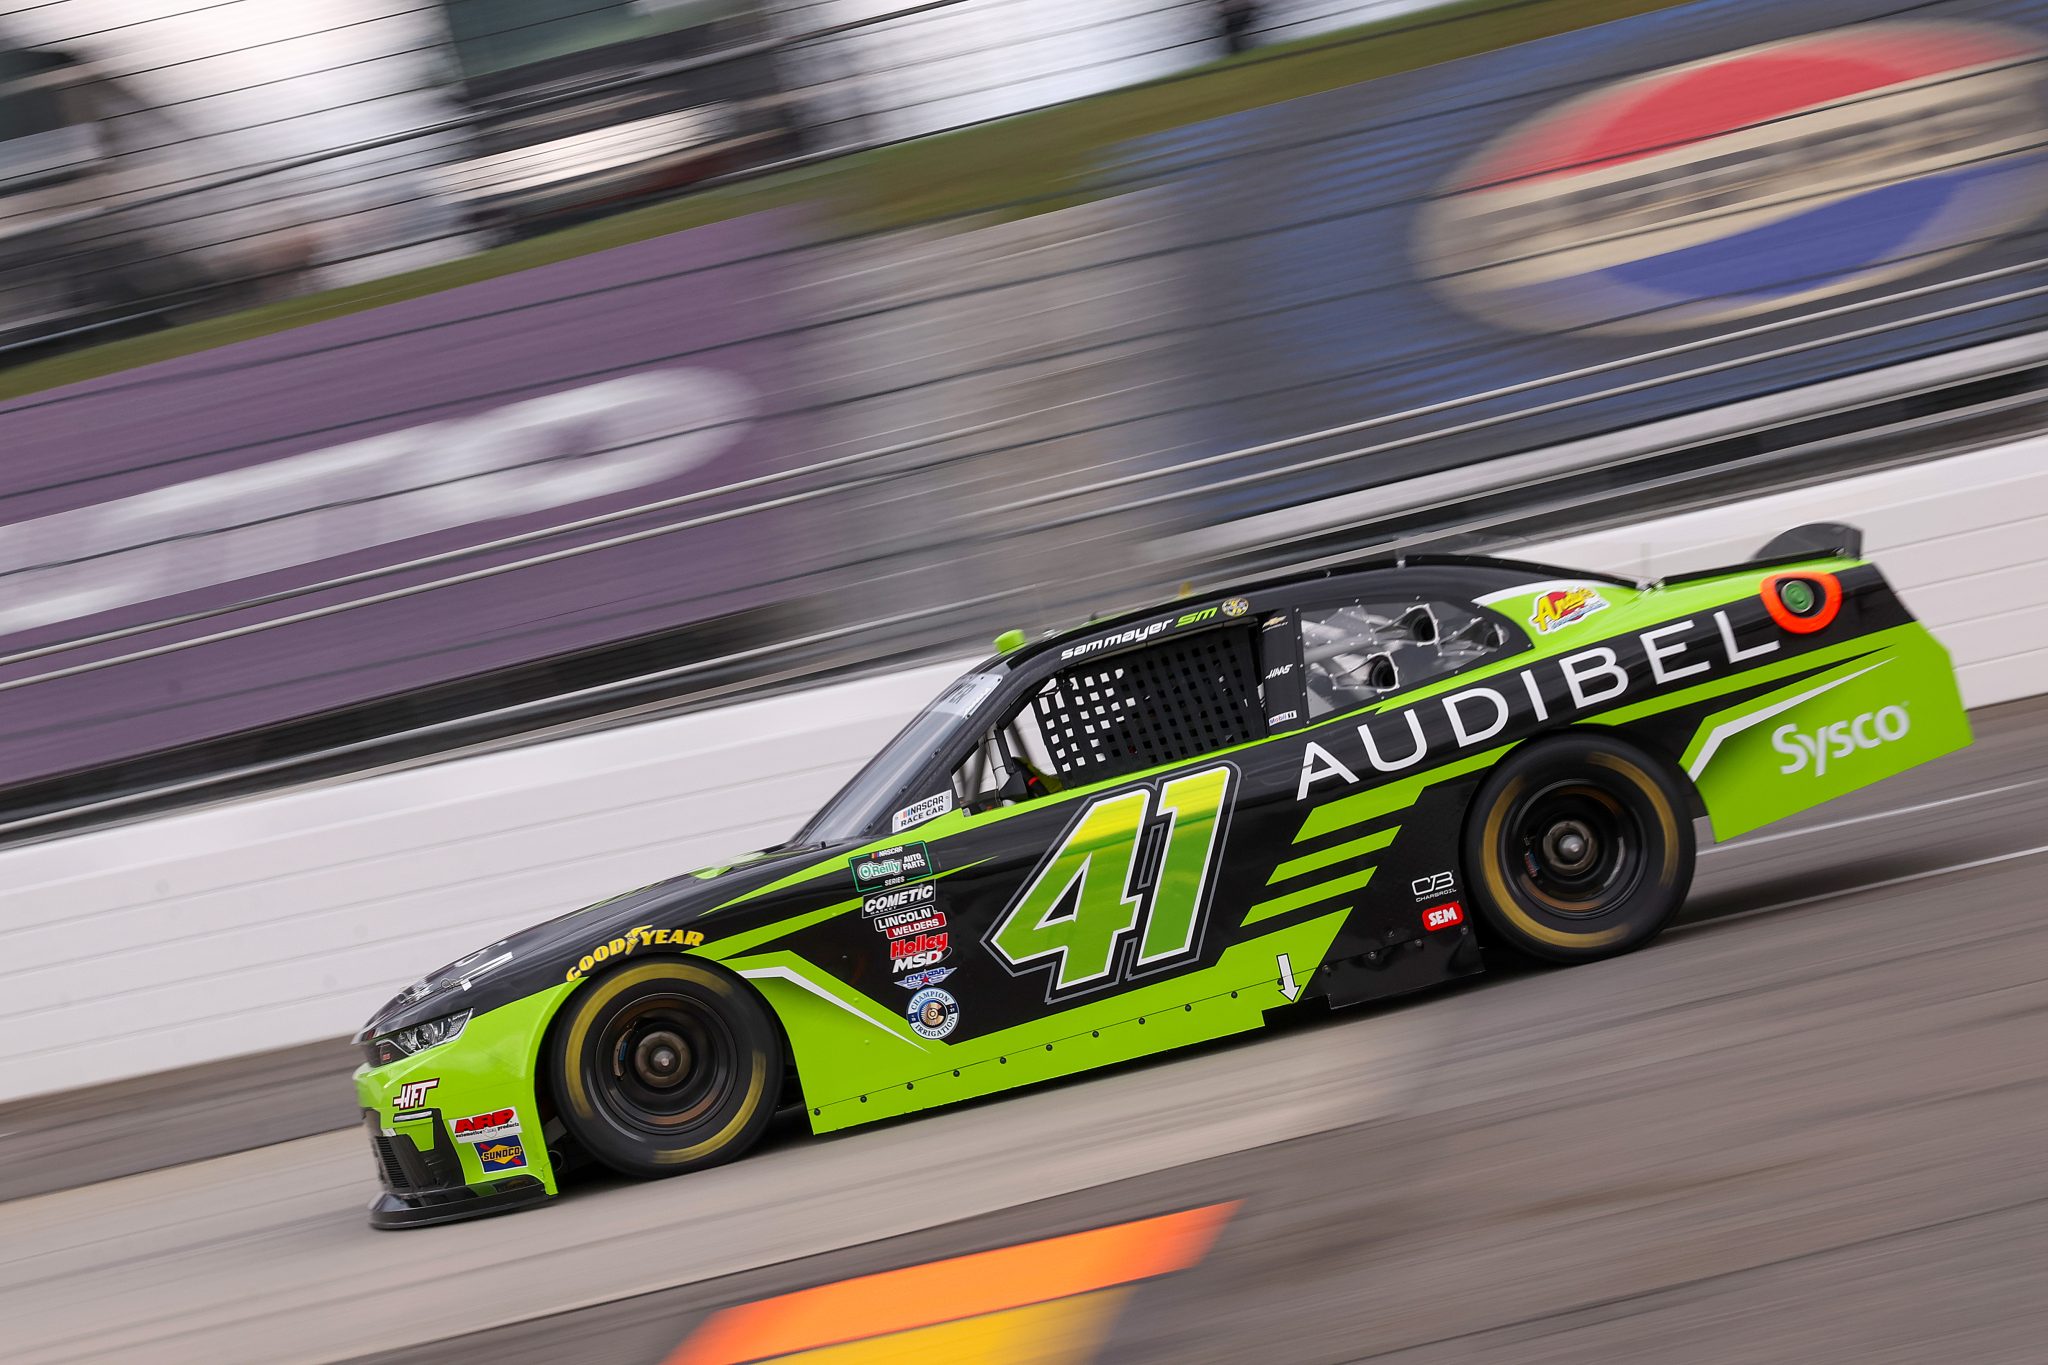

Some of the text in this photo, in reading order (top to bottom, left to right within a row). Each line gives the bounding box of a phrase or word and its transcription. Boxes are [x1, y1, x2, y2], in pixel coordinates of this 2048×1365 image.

[1297, 611, 1780, 800] AUDIBEL
[1772, 705, 1910, 777] Sysco
[910, 795, 944, 815] NASCAR
[901, 806, 944, 827] RACE CAR
[879, 846, 903, 857] NASCAR
[903, 853, 921, 863] AUTO
[903, 860, 925, 871] PARTS
[884, 876, 905, 886] SERIES
[991, 766, 1231, 990] 41
[865, 885, 933, 912] COMETIC
[878, 907, 931, 929] LINCOLN
[893, 918, 940, 936] WELDERS
[1428, 907, 1458, 927] SEM
[890, 933, 948, 960] Holley
[892, 951, 943, 973] MSD
[906, 972, 925, 983] FIVE
[910, 990, 951, 1011] CHAMPION
[914, 1016, 956, 1037] IRRIGATION
[455, 1109, 515, 1134] ARP
[497, 1121, 520, 1132] products
[482, 1146, 521, 1161] SUNOCO
